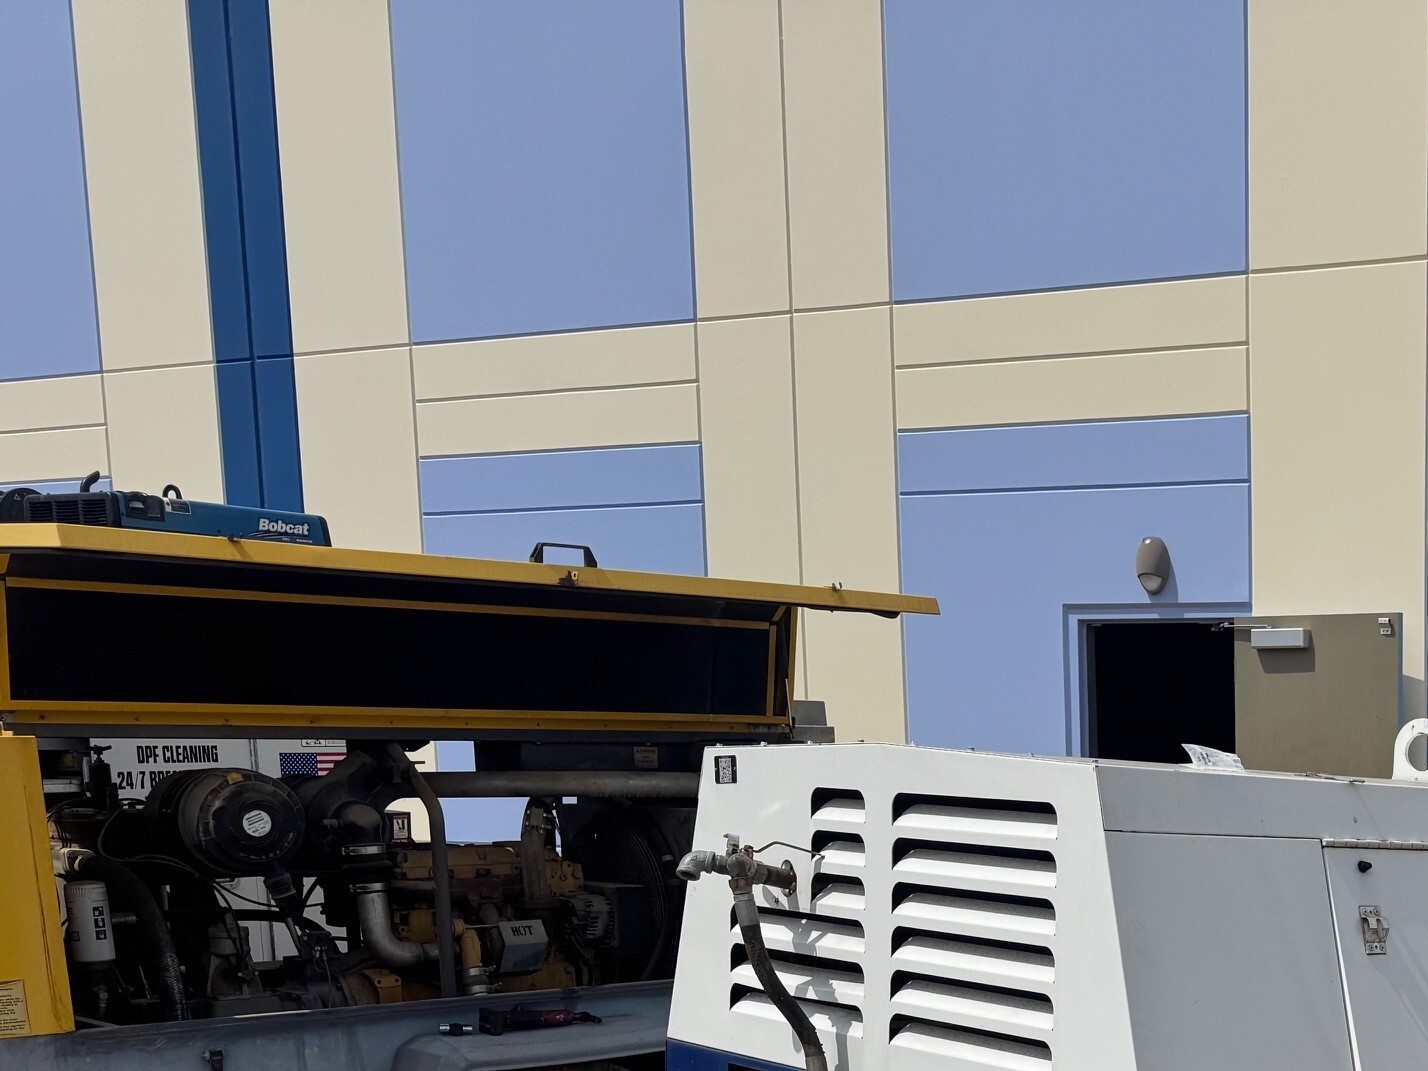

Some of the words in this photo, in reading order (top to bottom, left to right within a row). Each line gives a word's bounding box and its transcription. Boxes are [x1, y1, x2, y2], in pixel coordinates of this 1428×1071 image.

[258, 518, 309, 535] Bobcat
[136, 745, 159, 764] DPF
[162, 745, 219, 764] CLEANING
[117, 771, 146, 790] 24/7
[510, 925, 533, 937] HOT
